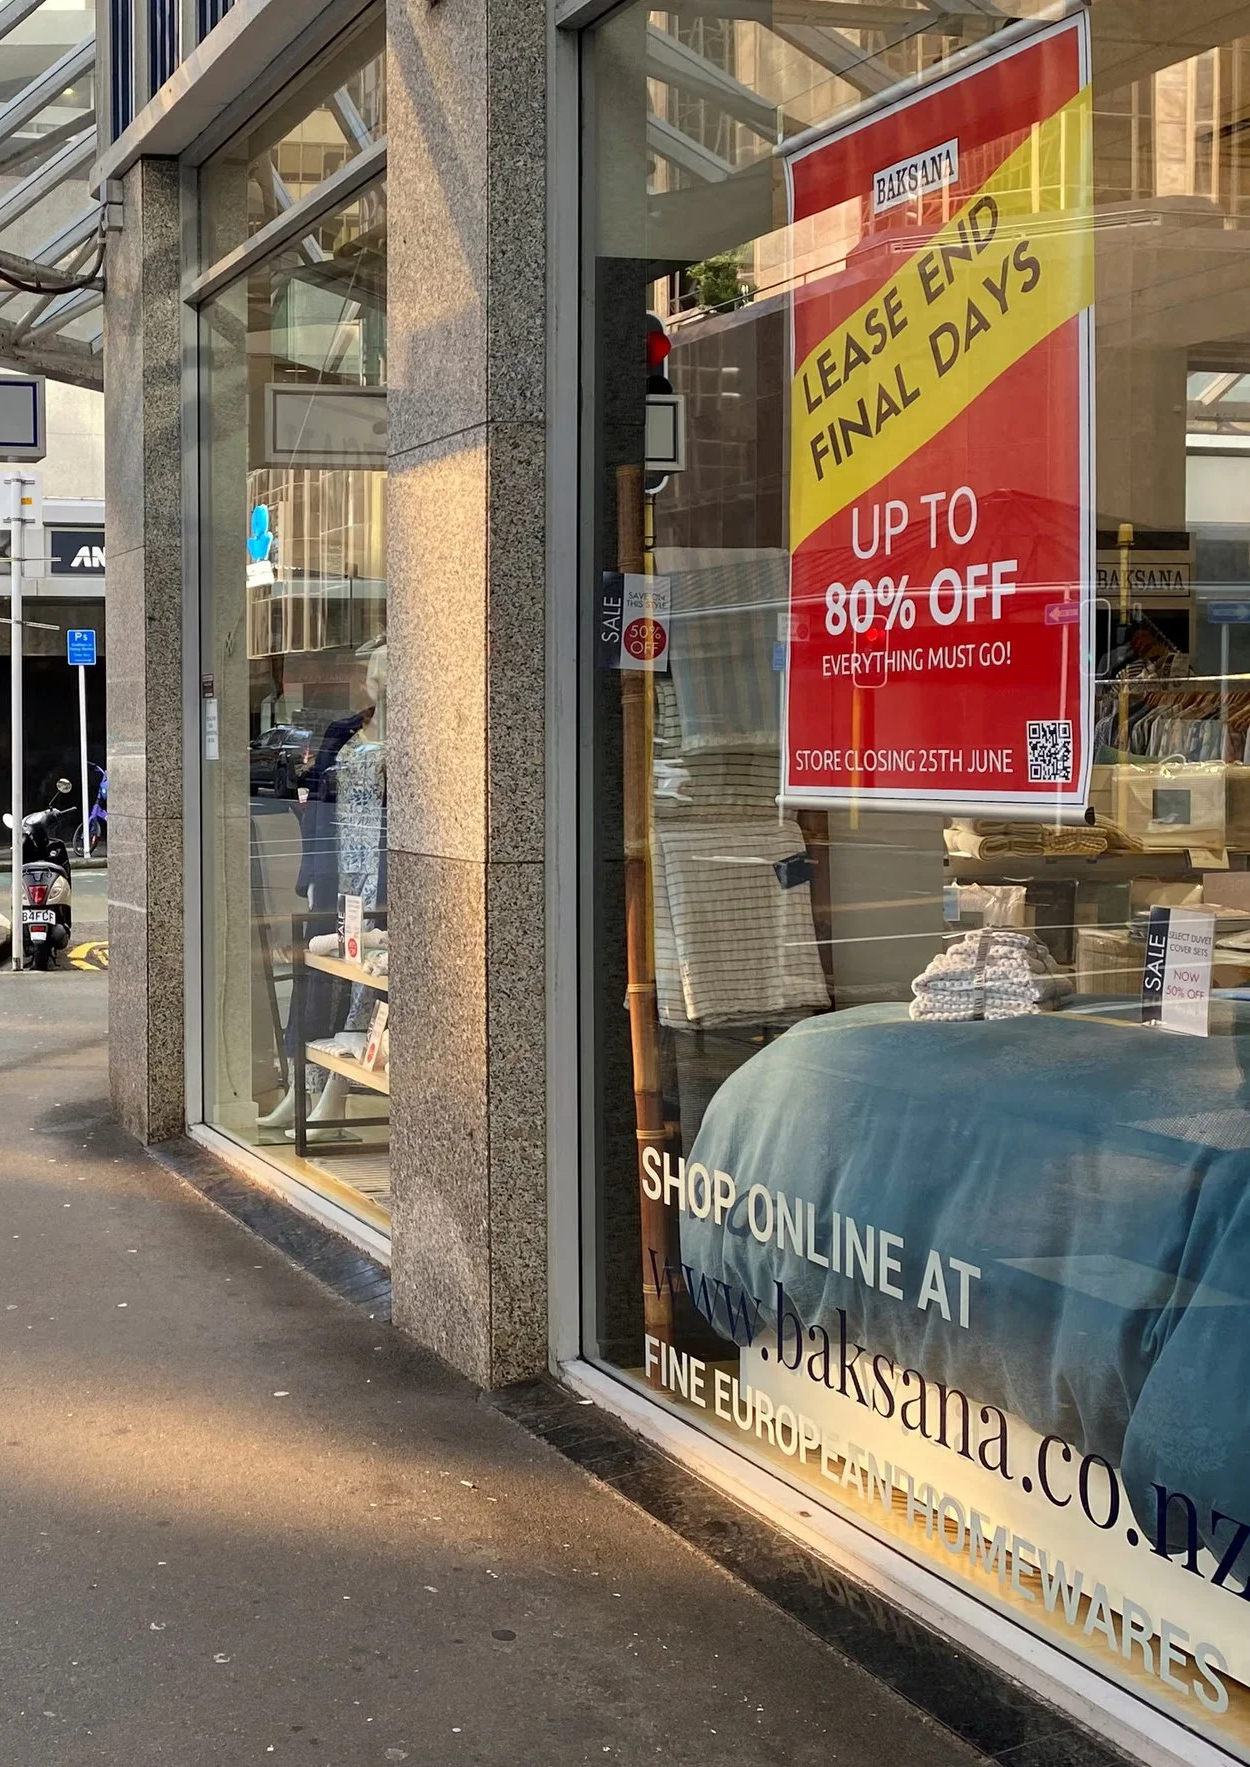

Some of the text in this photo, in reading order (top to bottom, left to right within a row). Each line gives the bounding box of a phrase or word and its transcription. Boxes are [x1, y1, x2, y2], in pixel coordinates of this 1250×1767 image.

[876, 148, 955, 206] BAKSANA
[802, 195, 999, 415] LEASE END
[809, 240, 1041, 482] FINAL DAYS
[852, 485, 978, 560] UP TO
[628, 592, 666, 601] SAVE ON
[825, 559, 1018, 636] 80% OFF
[1096, 569, 1185, 591] BAKSANA
[601, 596, 622, 643] SALE
[626, 600, 668, 610] THIS STYLE
[630, 625, 661, 639] 50%
[630, 641, 659, 655] OFF
[822, 641, 1012, 676] EVERYTHING MUST GO!
[795, 749, 1014, 773] STORE CLOSING 25TH JUNE
[1169, 931, 1212, 945] SELECT DUVET
[1170, 943, 1208, 957] COVER SETS
[1144, 934, 1166, 992] SALE
[1174, 970, 1200, 983] NOW
[1166, 985, 1205, 1000] 50% OFF
[642, 1146, 982, 1330] SHOP ONLINE AT
[647, 1246, 1250, 1602] www.baksana.co.nz
[644, 1333, 707, 1408] FINE
[714, 1368, 892, 1516] EUROPEAN
[906, 1472, 1229, 1714] HOMEWARES
